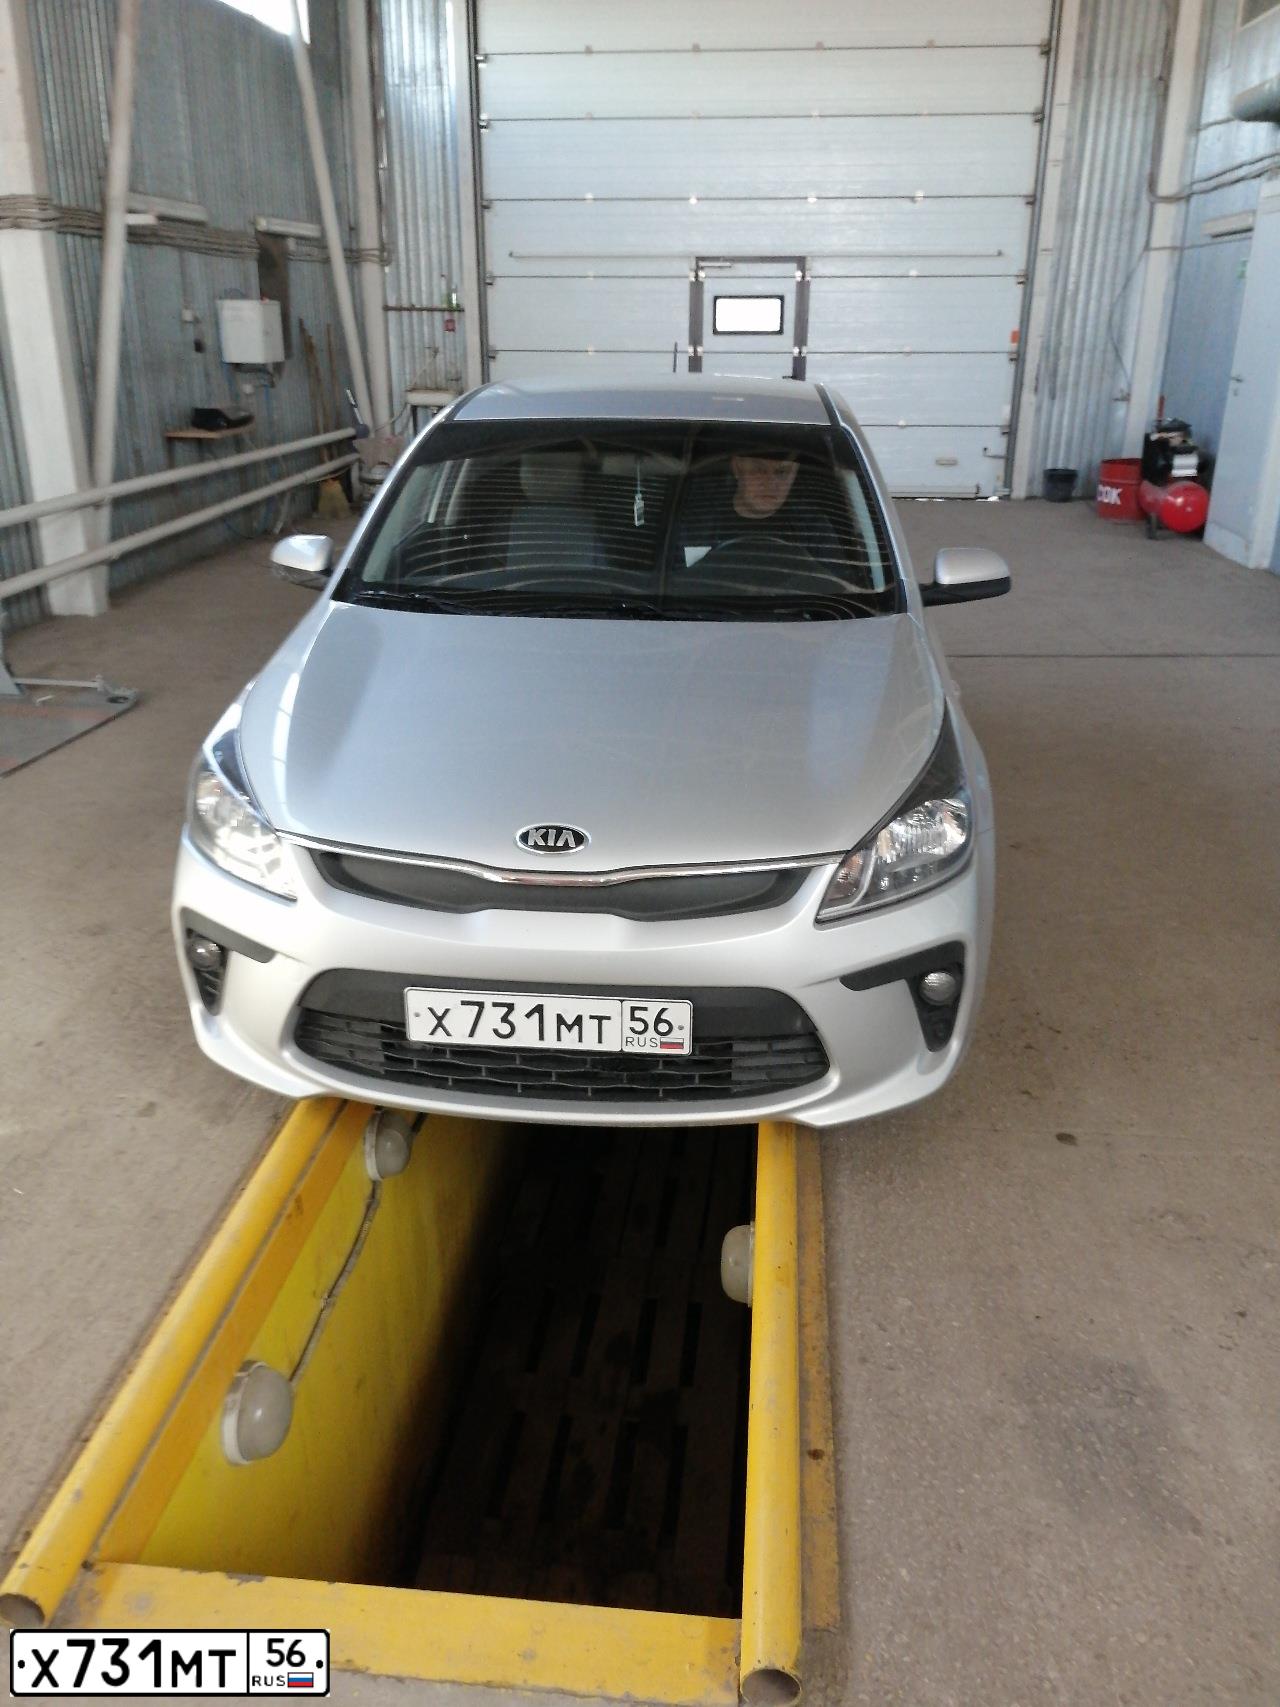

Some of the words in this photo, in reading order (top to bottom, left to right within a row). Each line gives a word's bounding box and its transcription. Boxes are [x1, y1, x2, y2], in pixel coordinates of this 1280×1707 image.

[527, 828, 576, 848] KIA
[629, 1006, 674, 1036] 56
[625, 1036, 658, 1048] RUS
